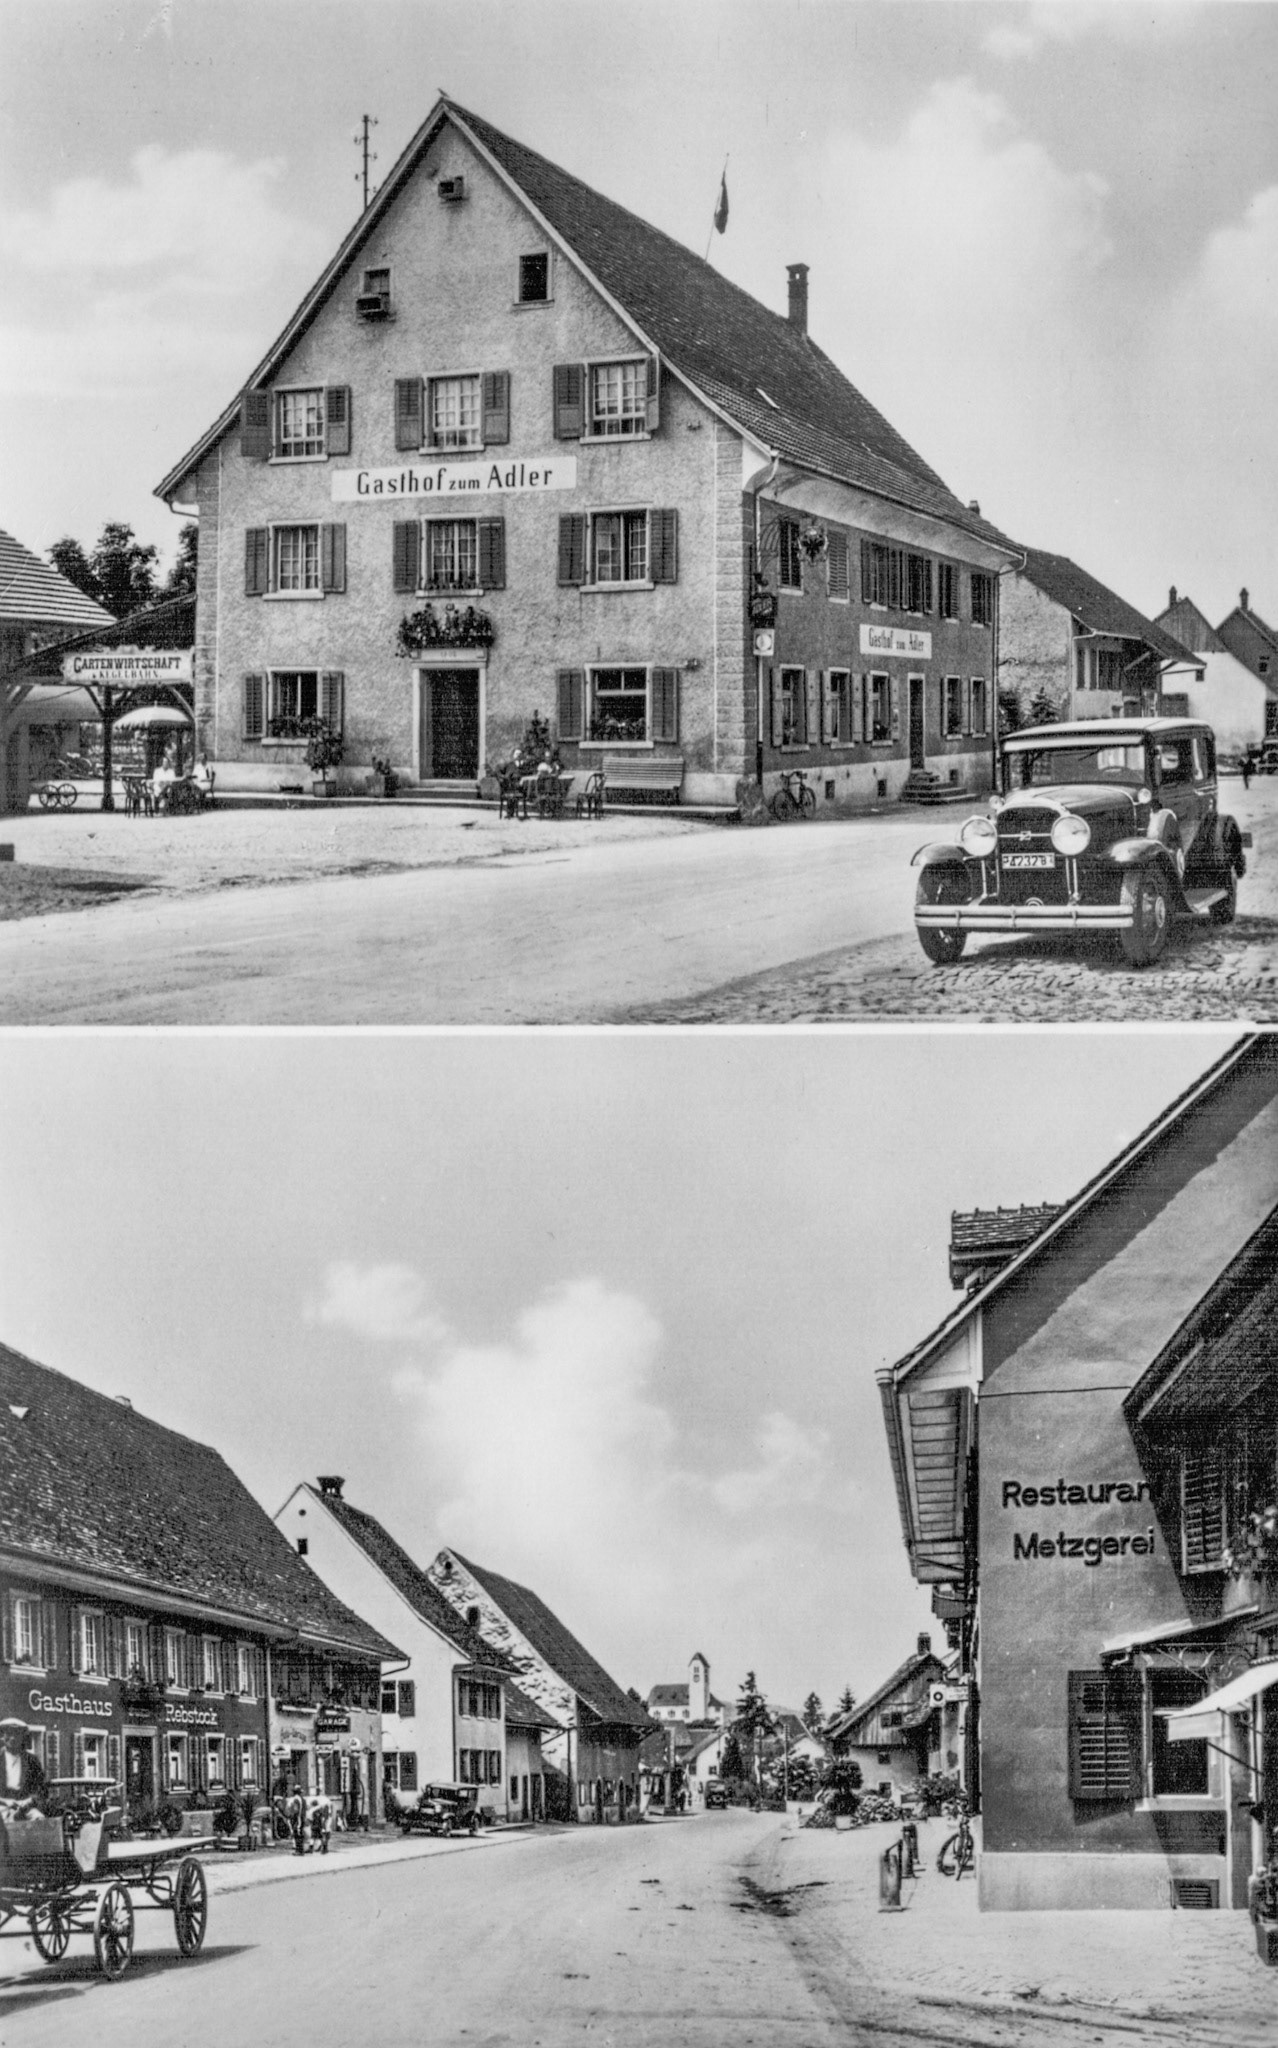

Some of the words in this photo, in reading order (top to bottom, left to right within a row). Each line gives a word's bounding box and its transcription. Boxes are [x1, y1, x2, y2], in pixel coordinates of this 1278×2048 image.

[357, 468, 446, 494] Gasthof
[449, 478, 480, 490] zum
[487, 464, 553, 488] Adler
[869, 627, 894, 649] Gasthof
[73, 657, 181, 673] GARTENWIRTSCHAFT
[1002, 1478, 1163, 1508] Restauran
[1013, 1528, 1154, 1566] Metzgerei
[29, 1689, 113, 1717] Gasthaus
[165, 1703, 218, 1726] Rebstock
